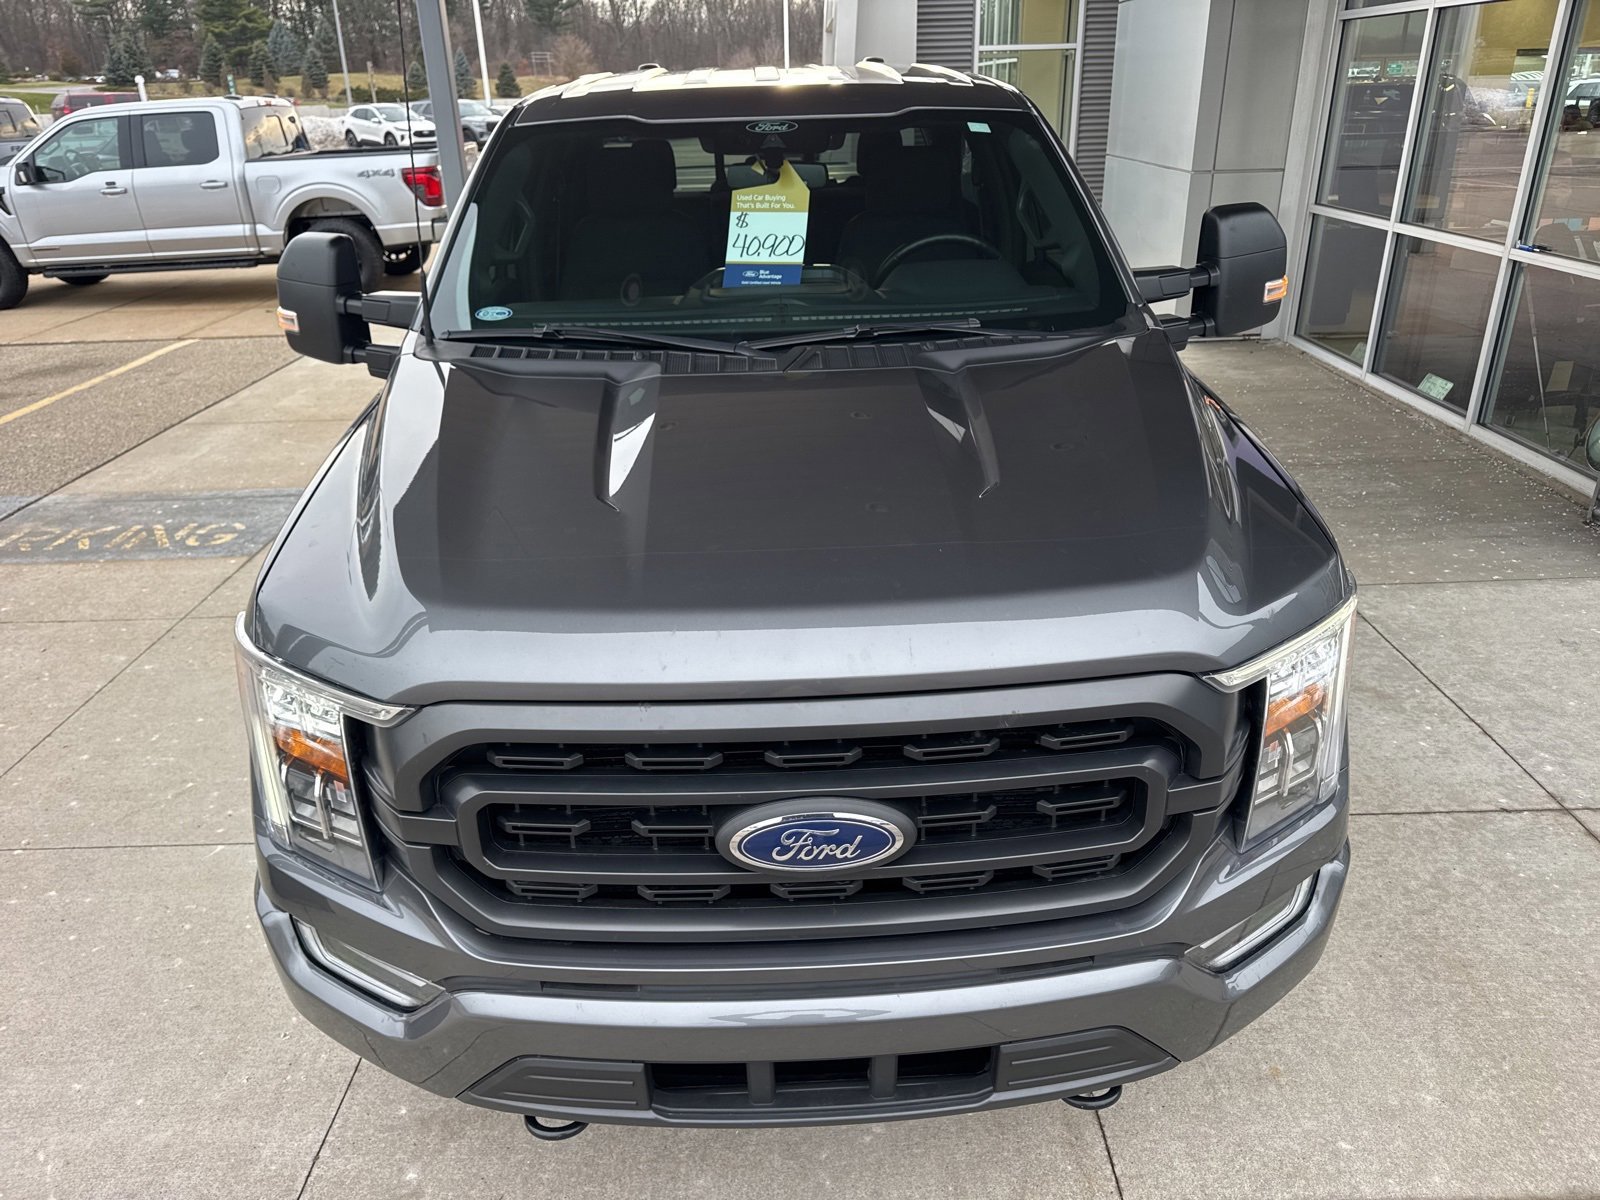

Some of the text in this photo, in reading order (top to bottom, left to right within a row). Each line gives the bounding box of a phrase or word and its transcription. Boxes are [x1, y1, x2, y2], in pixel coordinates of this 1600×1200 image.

[755, 121, 789, 131] Ford
[765, 194, 786, 202] Buying
[736, 211, 749, 228] $
[771, 828, 863, 862] Ford
